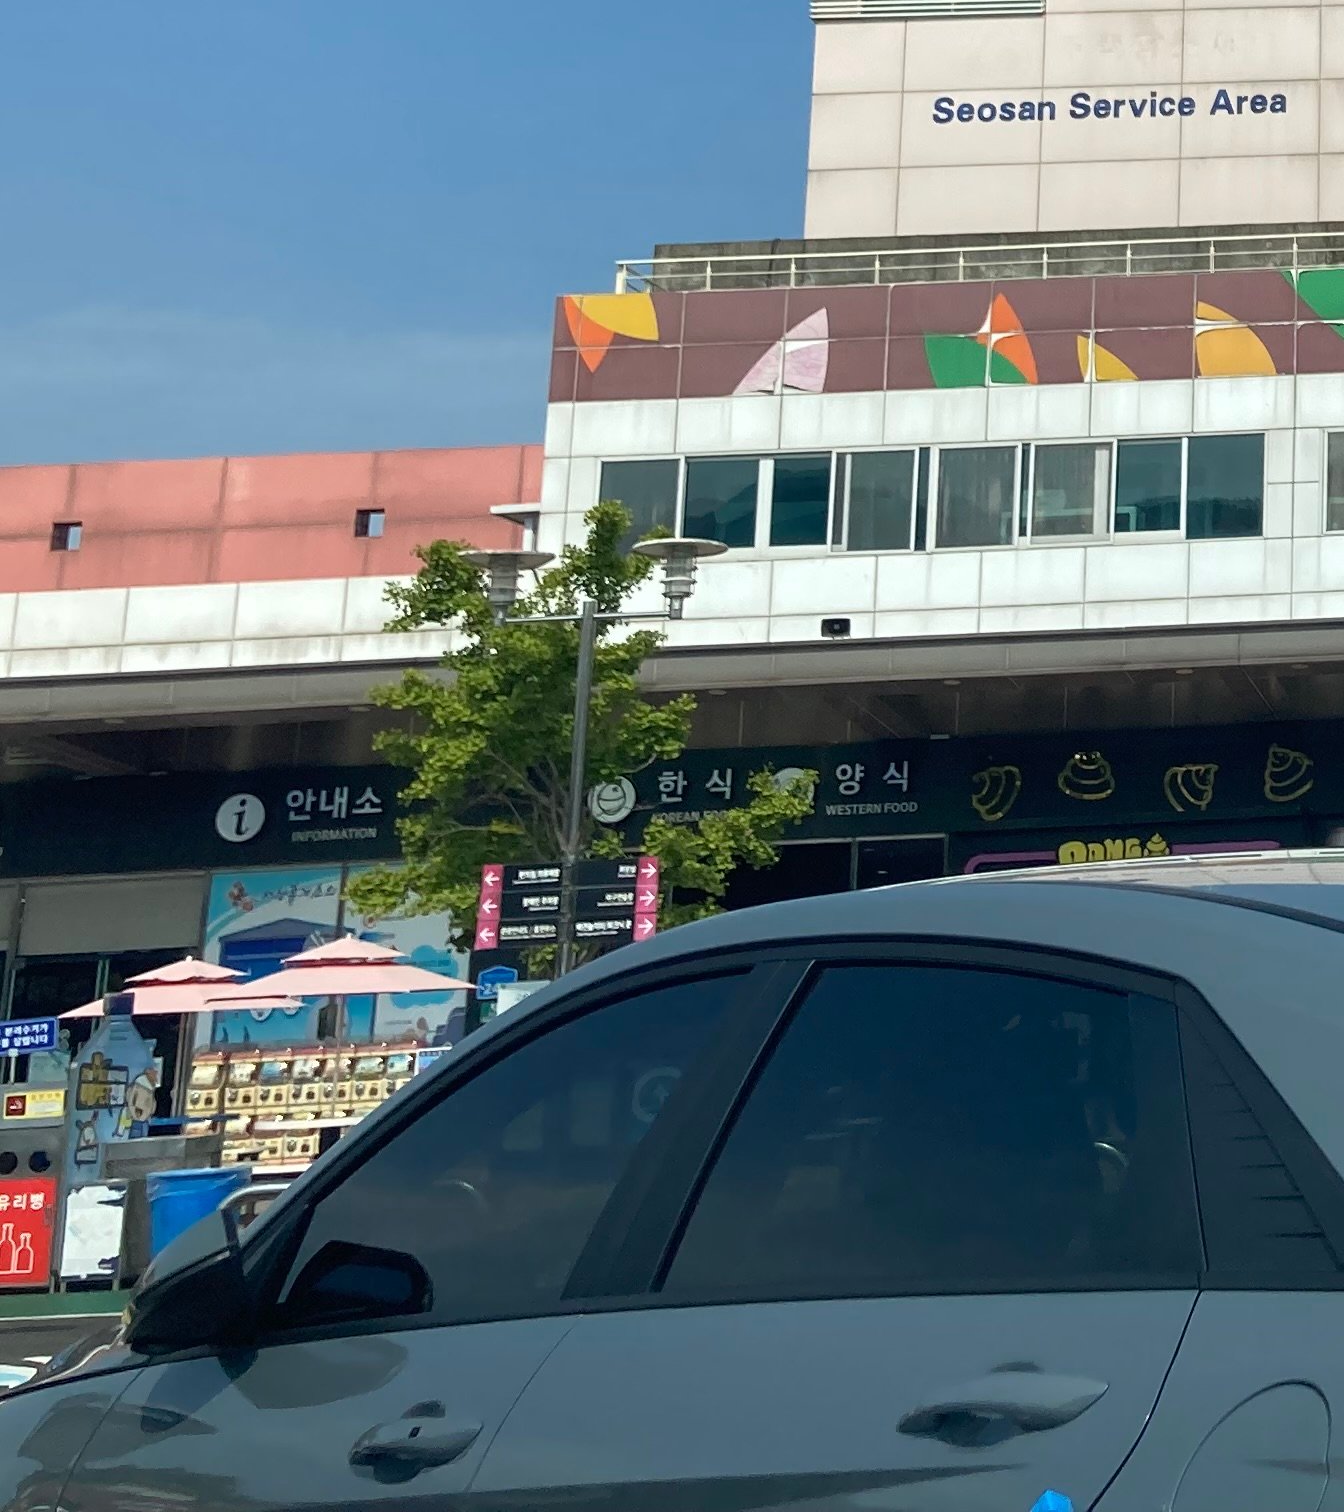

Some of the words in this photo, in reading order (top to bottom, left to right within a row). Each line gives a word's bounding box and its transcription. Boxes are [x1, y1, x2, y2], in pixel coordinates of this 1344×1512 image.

[932, 96, 1056, 125] Seosan
[1068, 91, 1196, 120] Service
[1209, 88, 1288, 116] Area
[285, 785, 384, 822] 안내소
[825, 803, 882, 818] WESTERN
[883, 801, 919, 815] FOOD
[0, 1191, 46, 1211] 유리병
